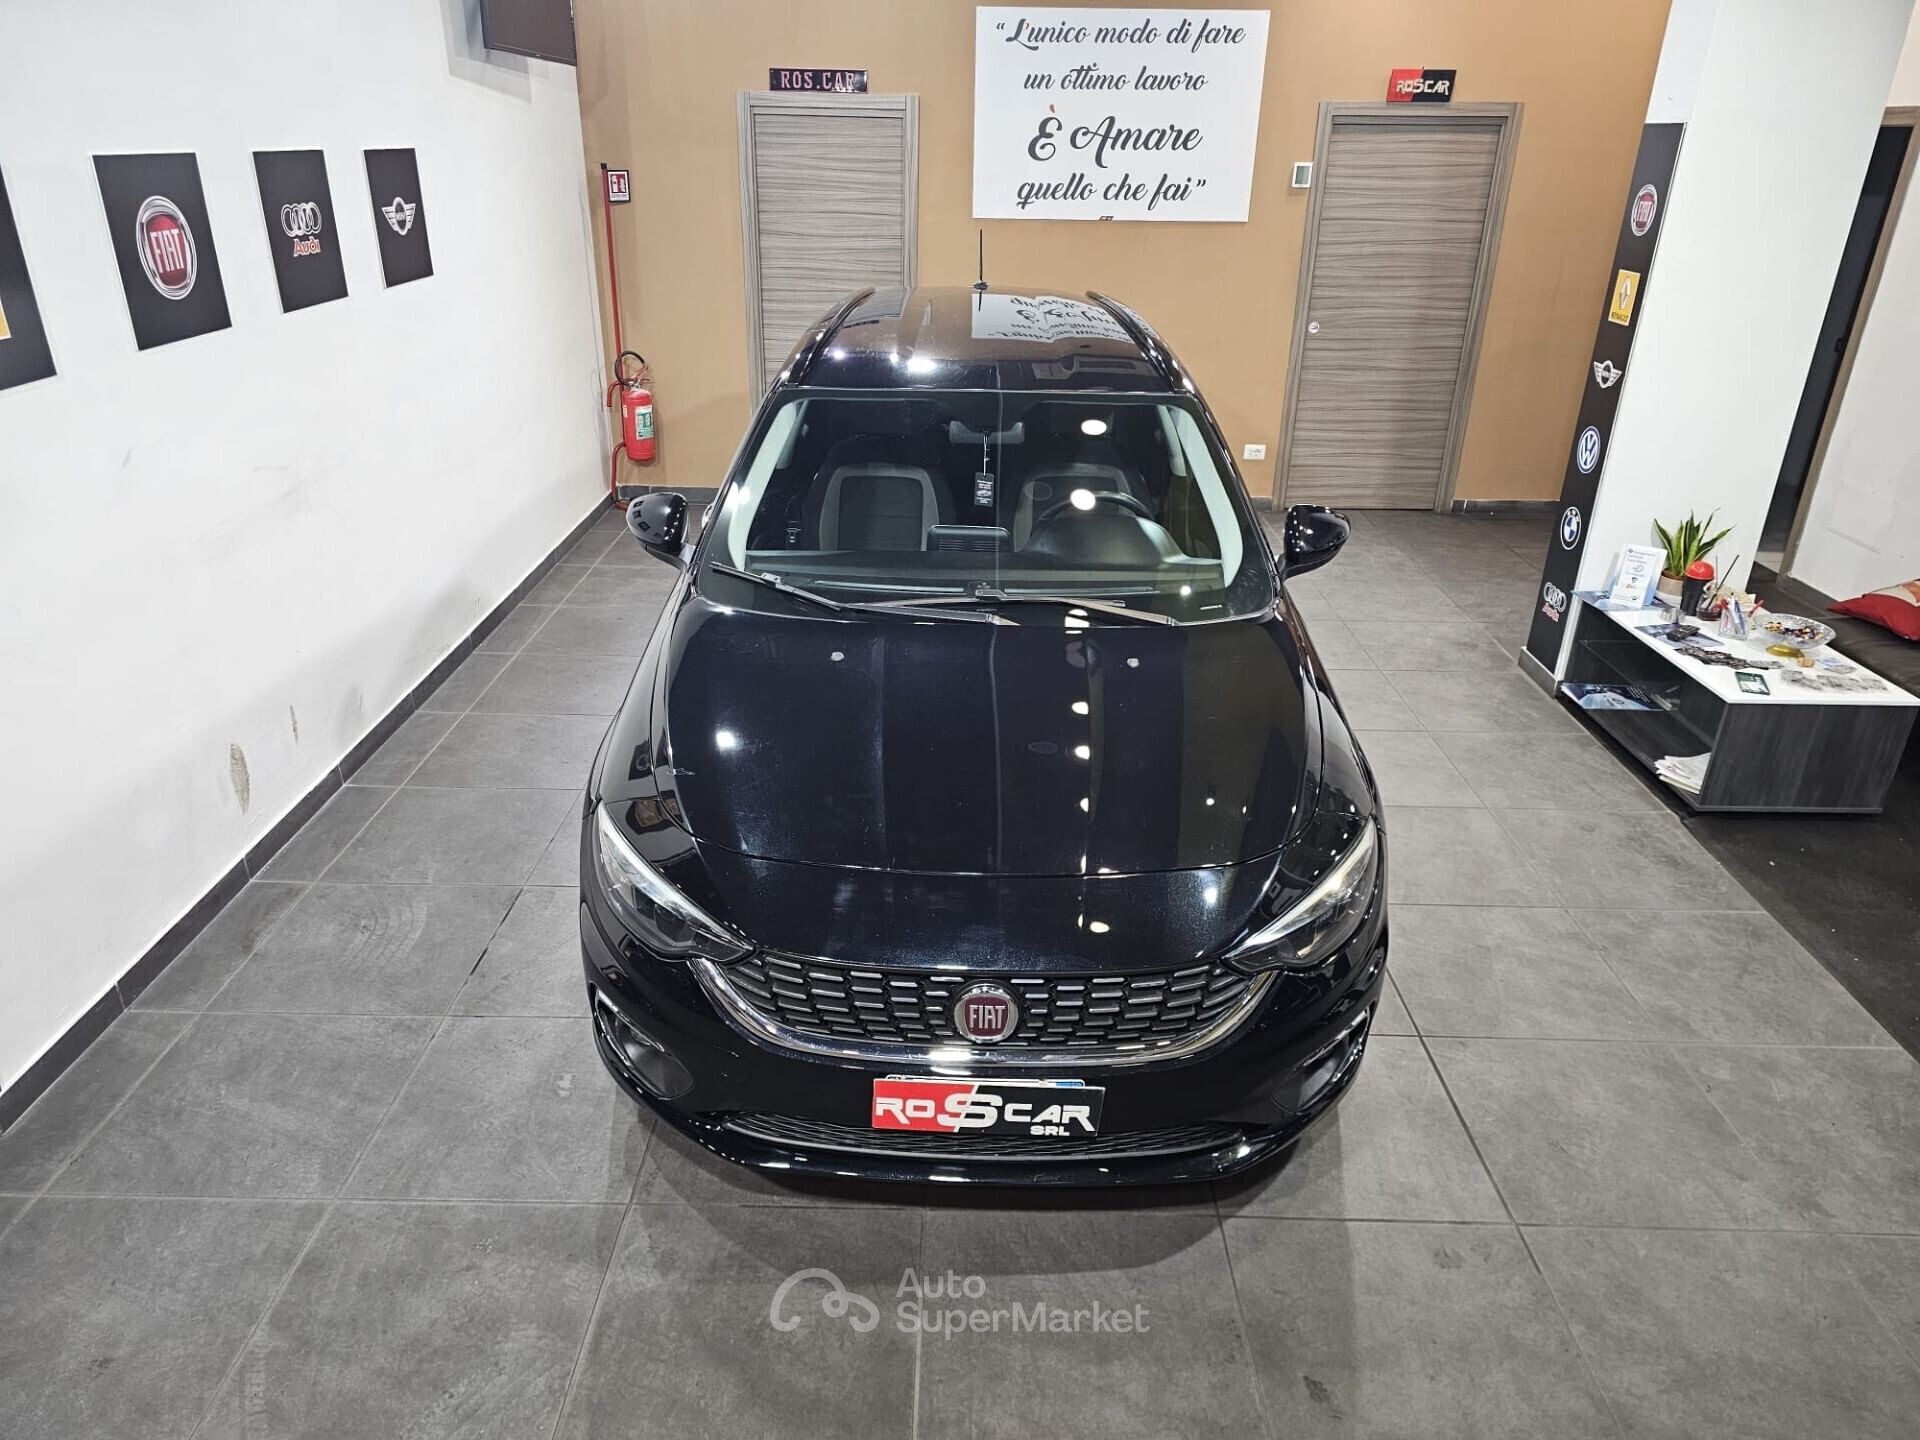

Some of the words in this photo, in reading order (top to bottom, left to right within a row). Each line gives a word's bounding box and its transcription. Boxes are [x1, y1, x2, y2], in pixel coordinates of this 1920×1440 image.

[1094, 18, 1161, 44] modo
[1166, 18, 1192, 44] di
[1191, 18, 1247, 53] fare
[1023, 72, 1055, 91] un
[1060, 62, 1130, 91] ottimo
[1134, 65, 1209, 91] lavoro
[1396, 78, 1450, 96] ROSCAR
[1027, 103, 1063, 162] È
[1070, 115, 1203, 169] Amare
[1016, 172, 1097, 210] quello
[1103, 173, 1148, 201] che
[149, 227, 185, 274] FIAT
[293, 236, 321, 257] Audi
[968, 1004, 1007, 1031] FIAT
[1030, 1125, 1070, 1137] SRL
